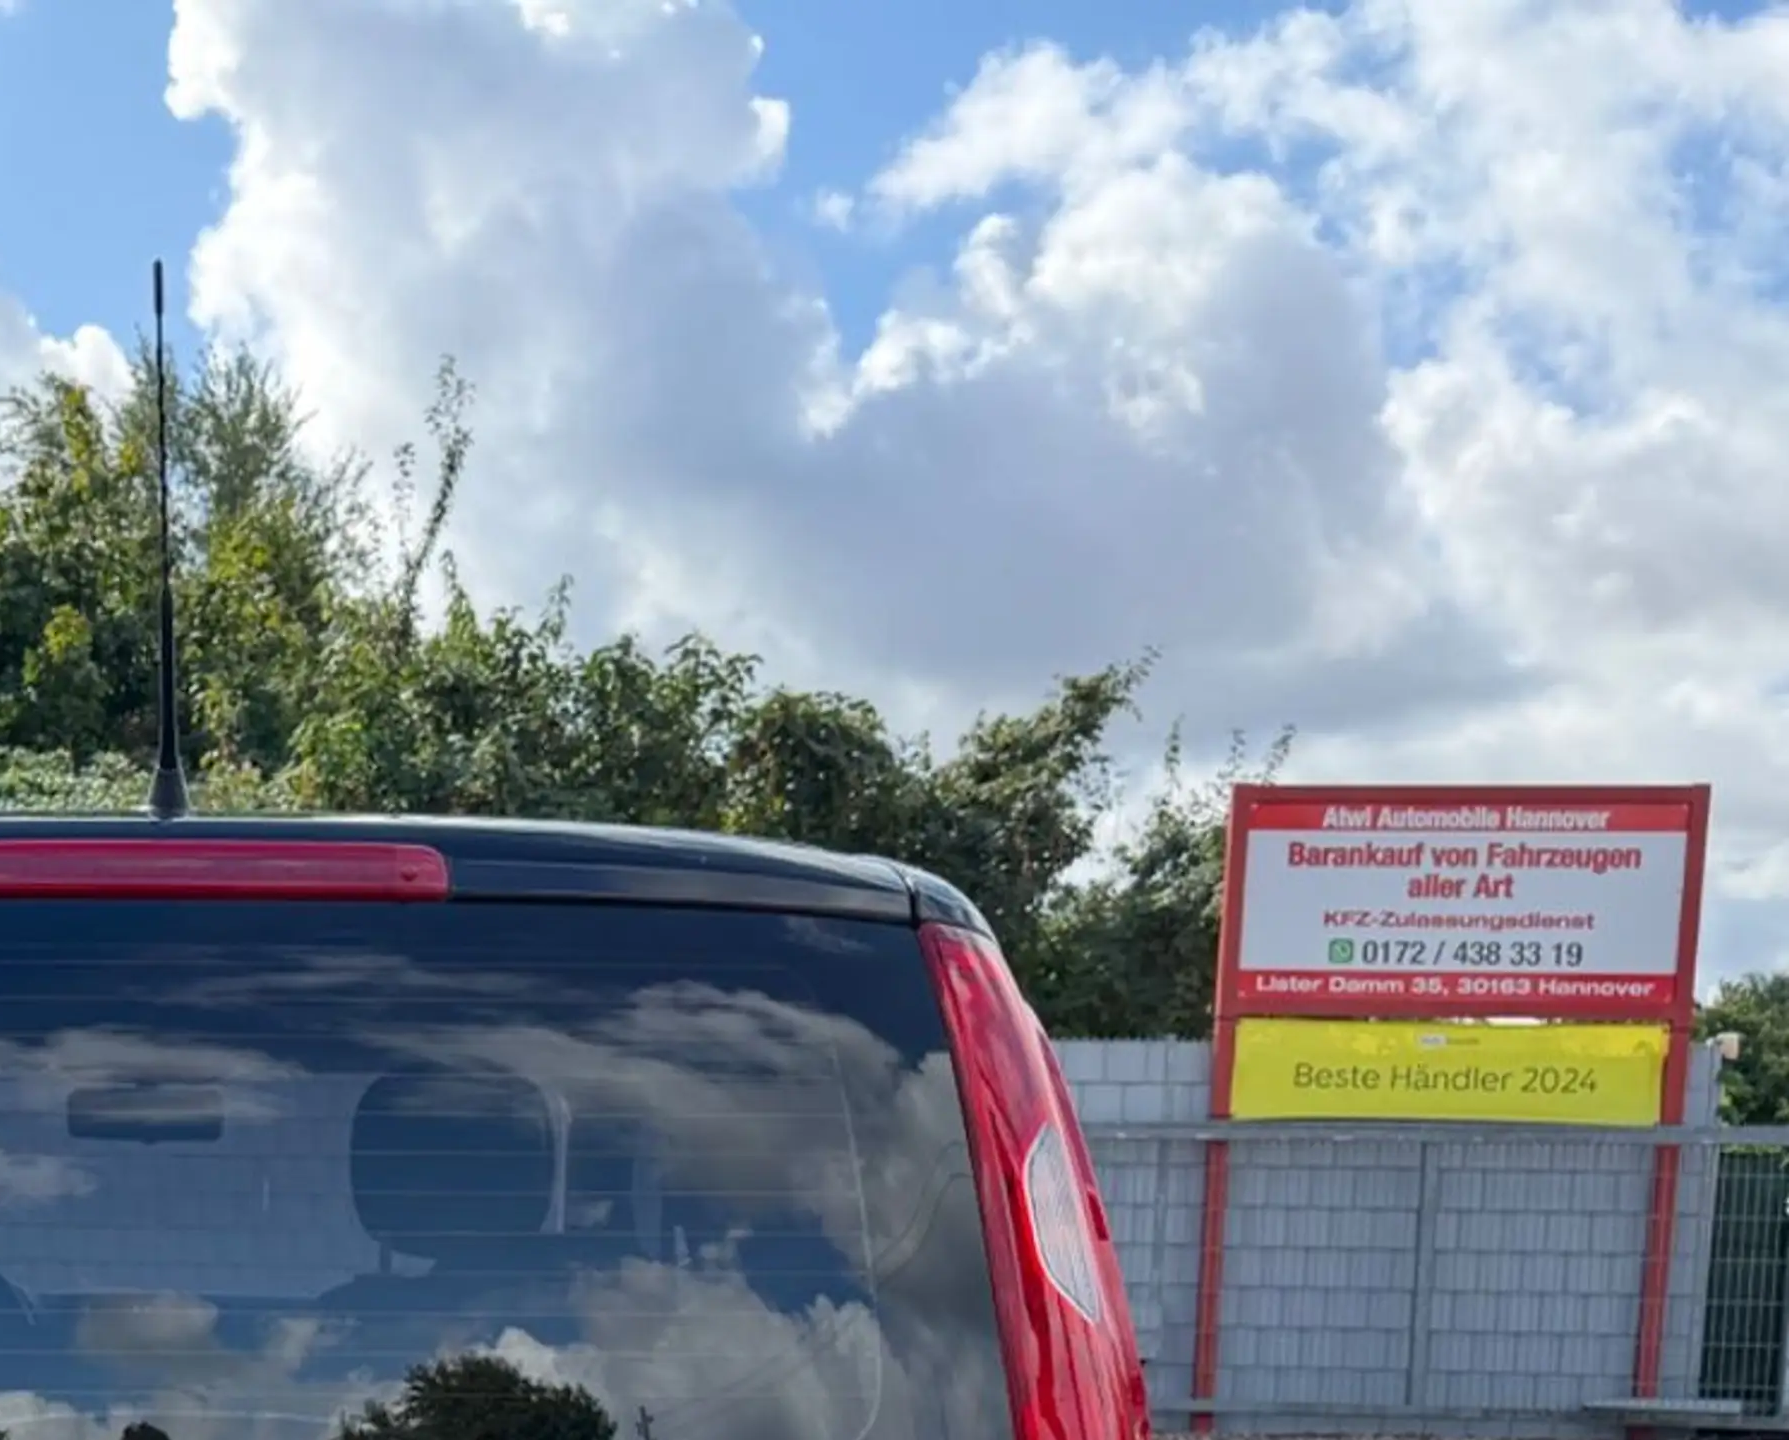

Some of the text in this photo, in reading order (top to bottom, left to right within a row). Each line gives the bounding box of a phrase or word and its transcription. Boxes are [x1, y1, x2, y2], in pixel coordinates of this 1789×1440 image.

[1377, 806, 1500, 829] Automobile
[1506, 806, 1610, 830] Hannover
[1288, 842, 1642, 874] Barankauf von Fahrzeugen
[1408, 873, 1515, 899] aller Art
[1323, 911, 1595, 932] KFZ-Zulassungsdienst
[1362, 940, 1583, 967] 0172 / 438 33 19
[1256, 975, 1655, 997] Lister Damm 35, 30163 Hannover
[1293, 1062, 1598, 1094] Beste Händler 2024
